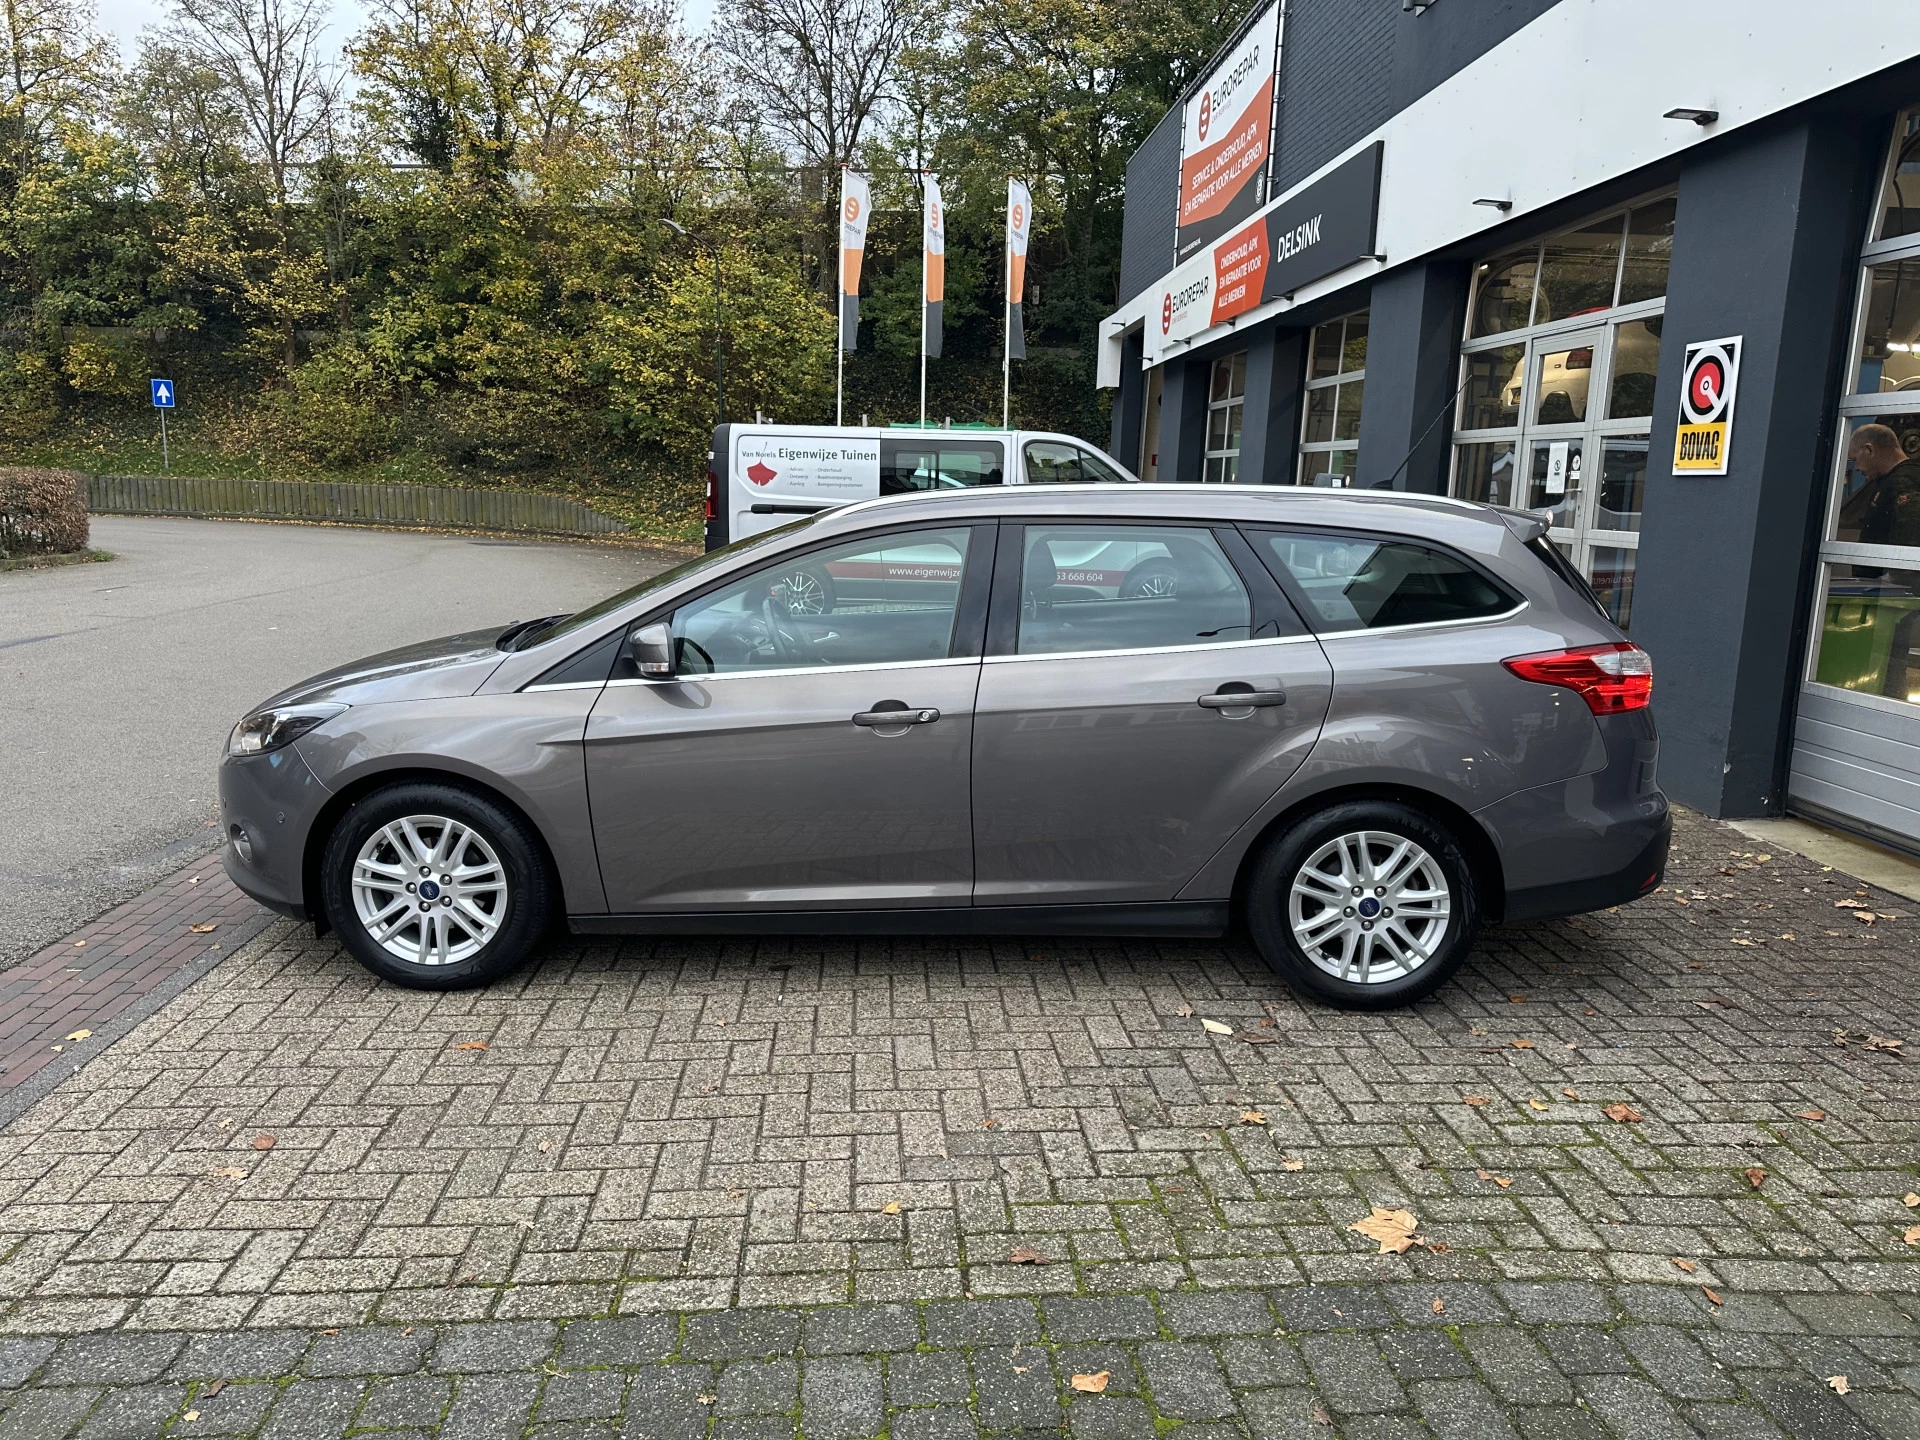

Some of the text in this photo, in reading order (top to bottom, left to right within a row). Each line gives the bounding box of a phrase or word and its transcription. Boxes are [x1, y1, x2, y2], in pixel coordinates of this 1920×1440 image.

[1212, 44, 1260, 112] EUROREPAR
[1215, 172, 1230, 193] VOOR
[1229, 160, 1241, 183] ALLE
[1241, 139, 1263, 171] MERKEN
[1192, 171, 1211, 190] SERVICE
[1248, 235, 1259, 252] APK
[1277, 213, 1322, 263] DELSINK
[1247, 254, 1262, 274] VOOR
[1172, 276, 1209, 313] EUROREPAR
[1218, 283, 1246, 309] ALLE MERKEN
[778, 448, 838, 461] Eigenwijze
[840, 449, 877, 461] Tuinen
[1679, 430, 1720, 461] BOVAG
[1068, 572, 1085, 581] 668
[1086, 573, 1103, 582] 604
